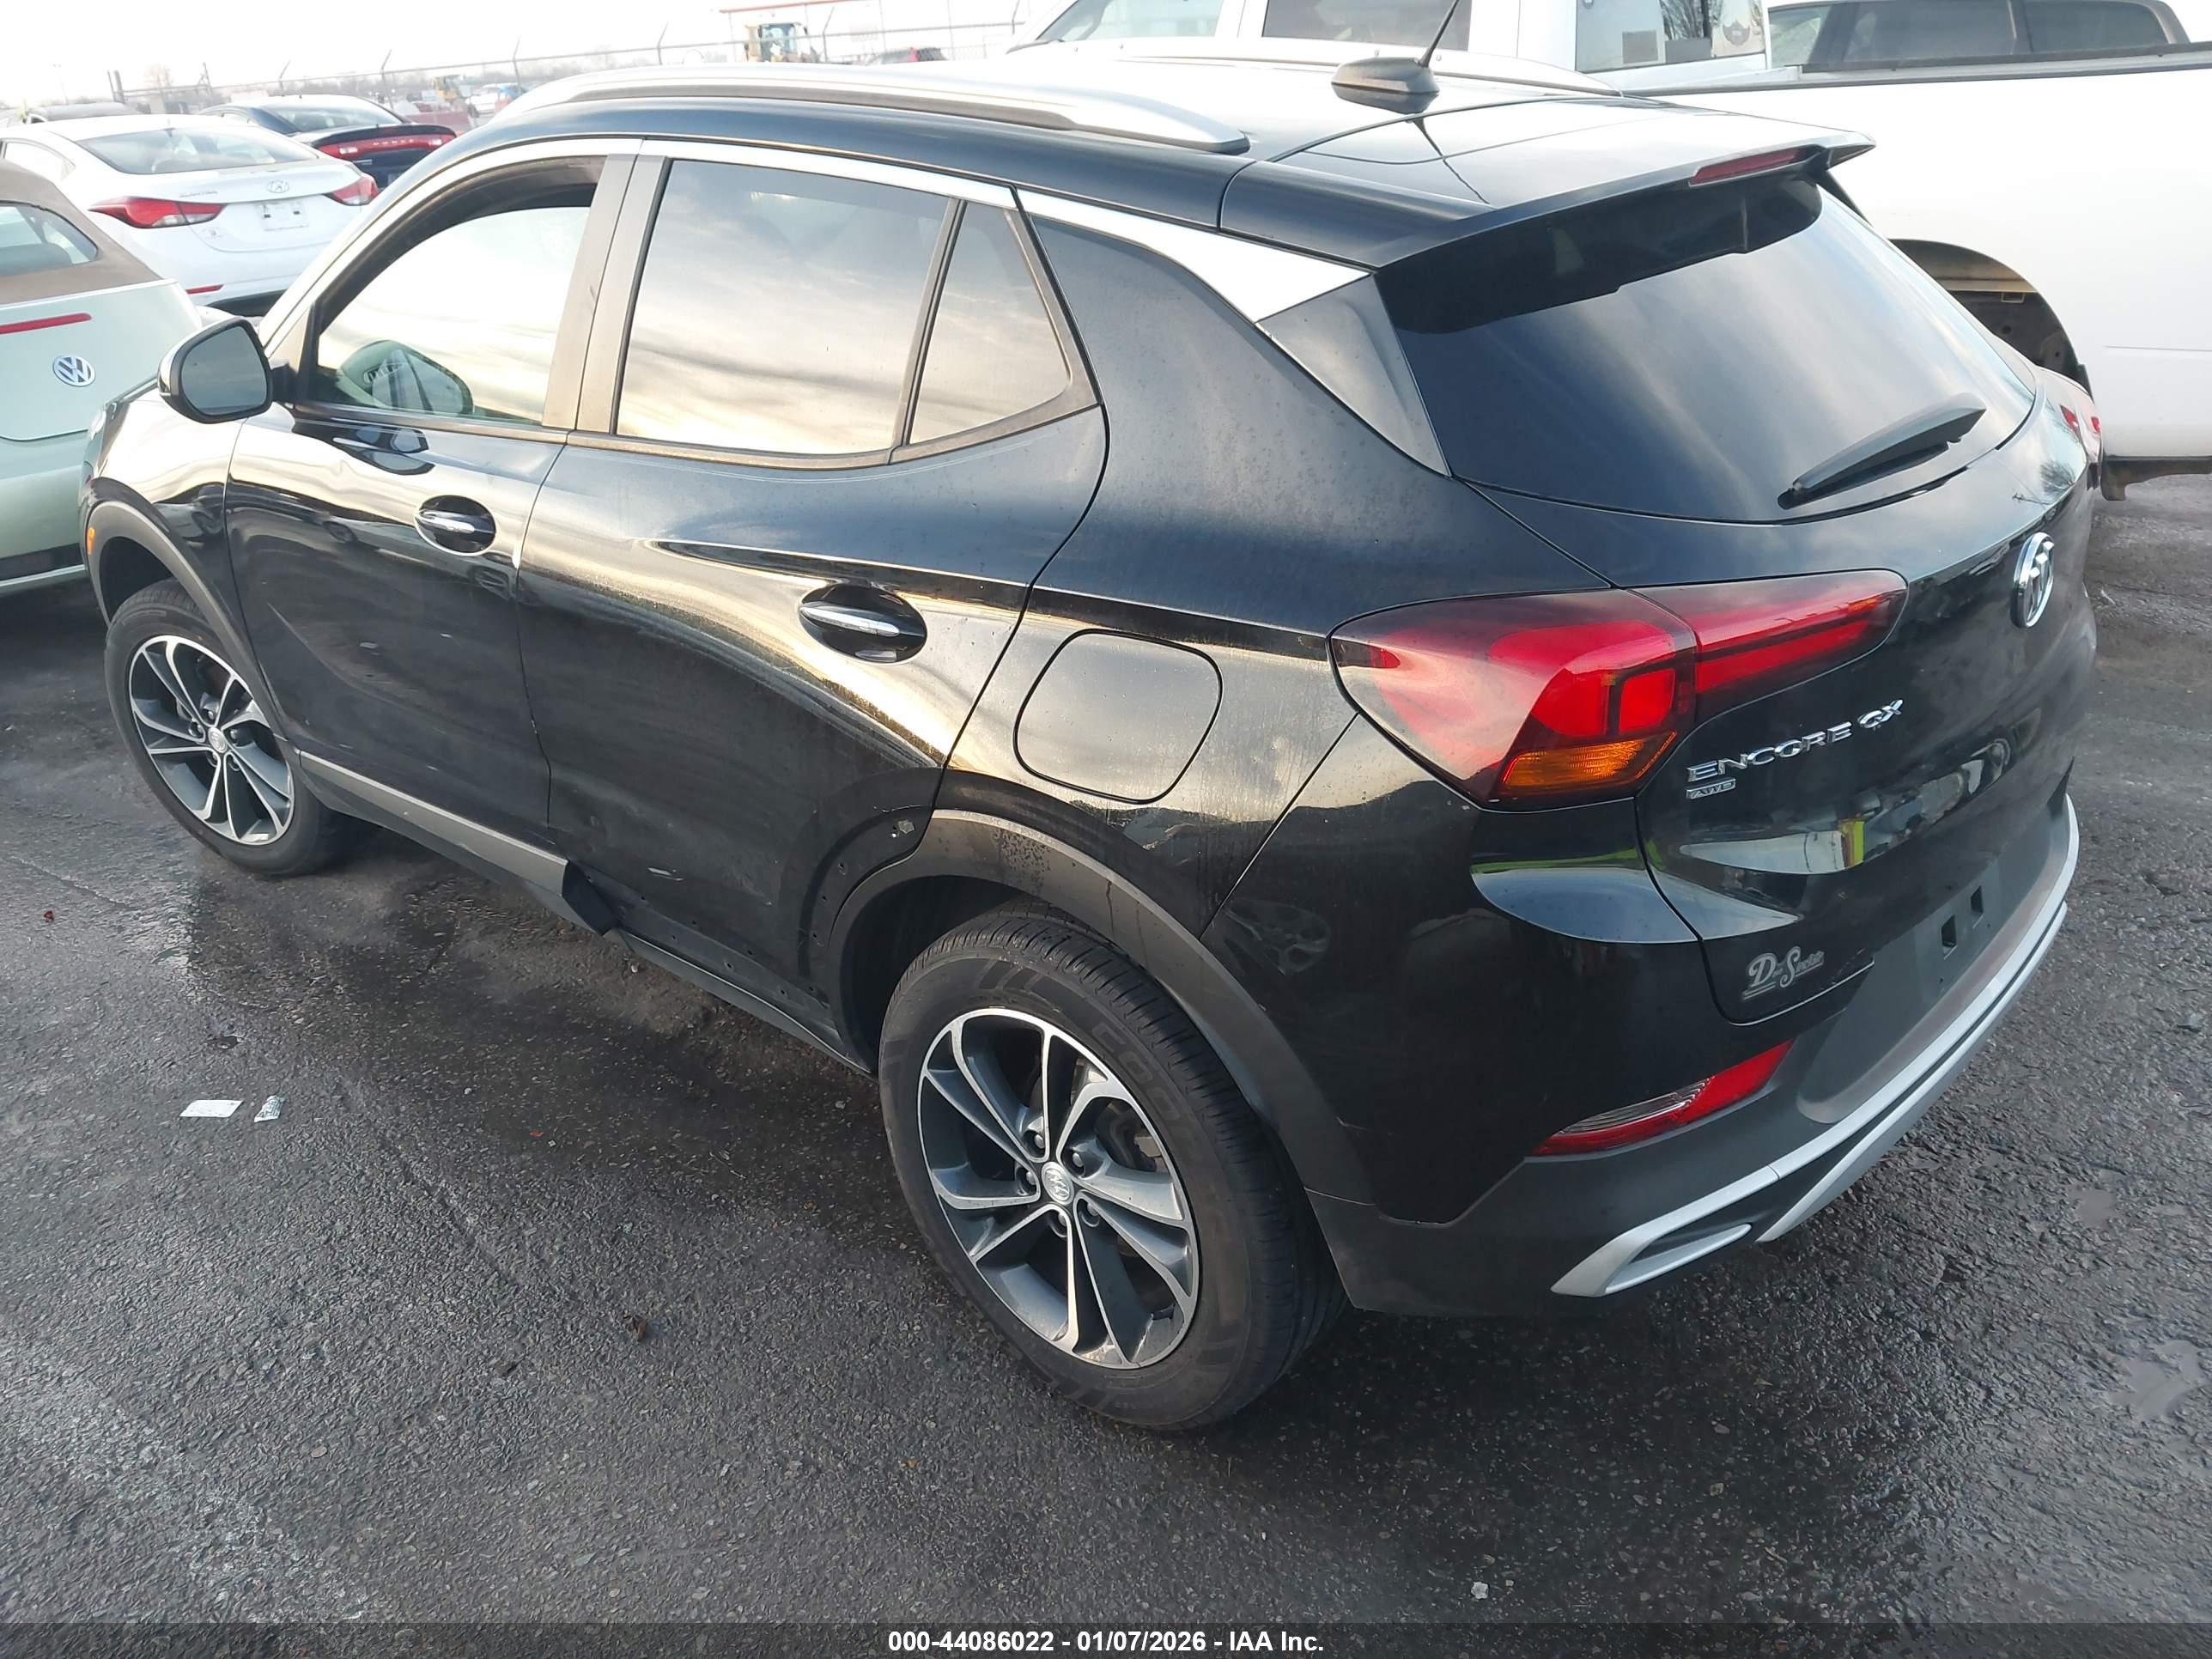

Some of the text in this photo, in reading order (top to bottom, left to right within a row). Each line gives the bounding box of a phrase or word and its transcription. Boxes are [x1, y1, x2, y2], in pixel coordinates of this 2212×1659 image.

[1686, 698, 1904, 782] ENCORE GX
[1686, 778, 1736, 799] AWD
